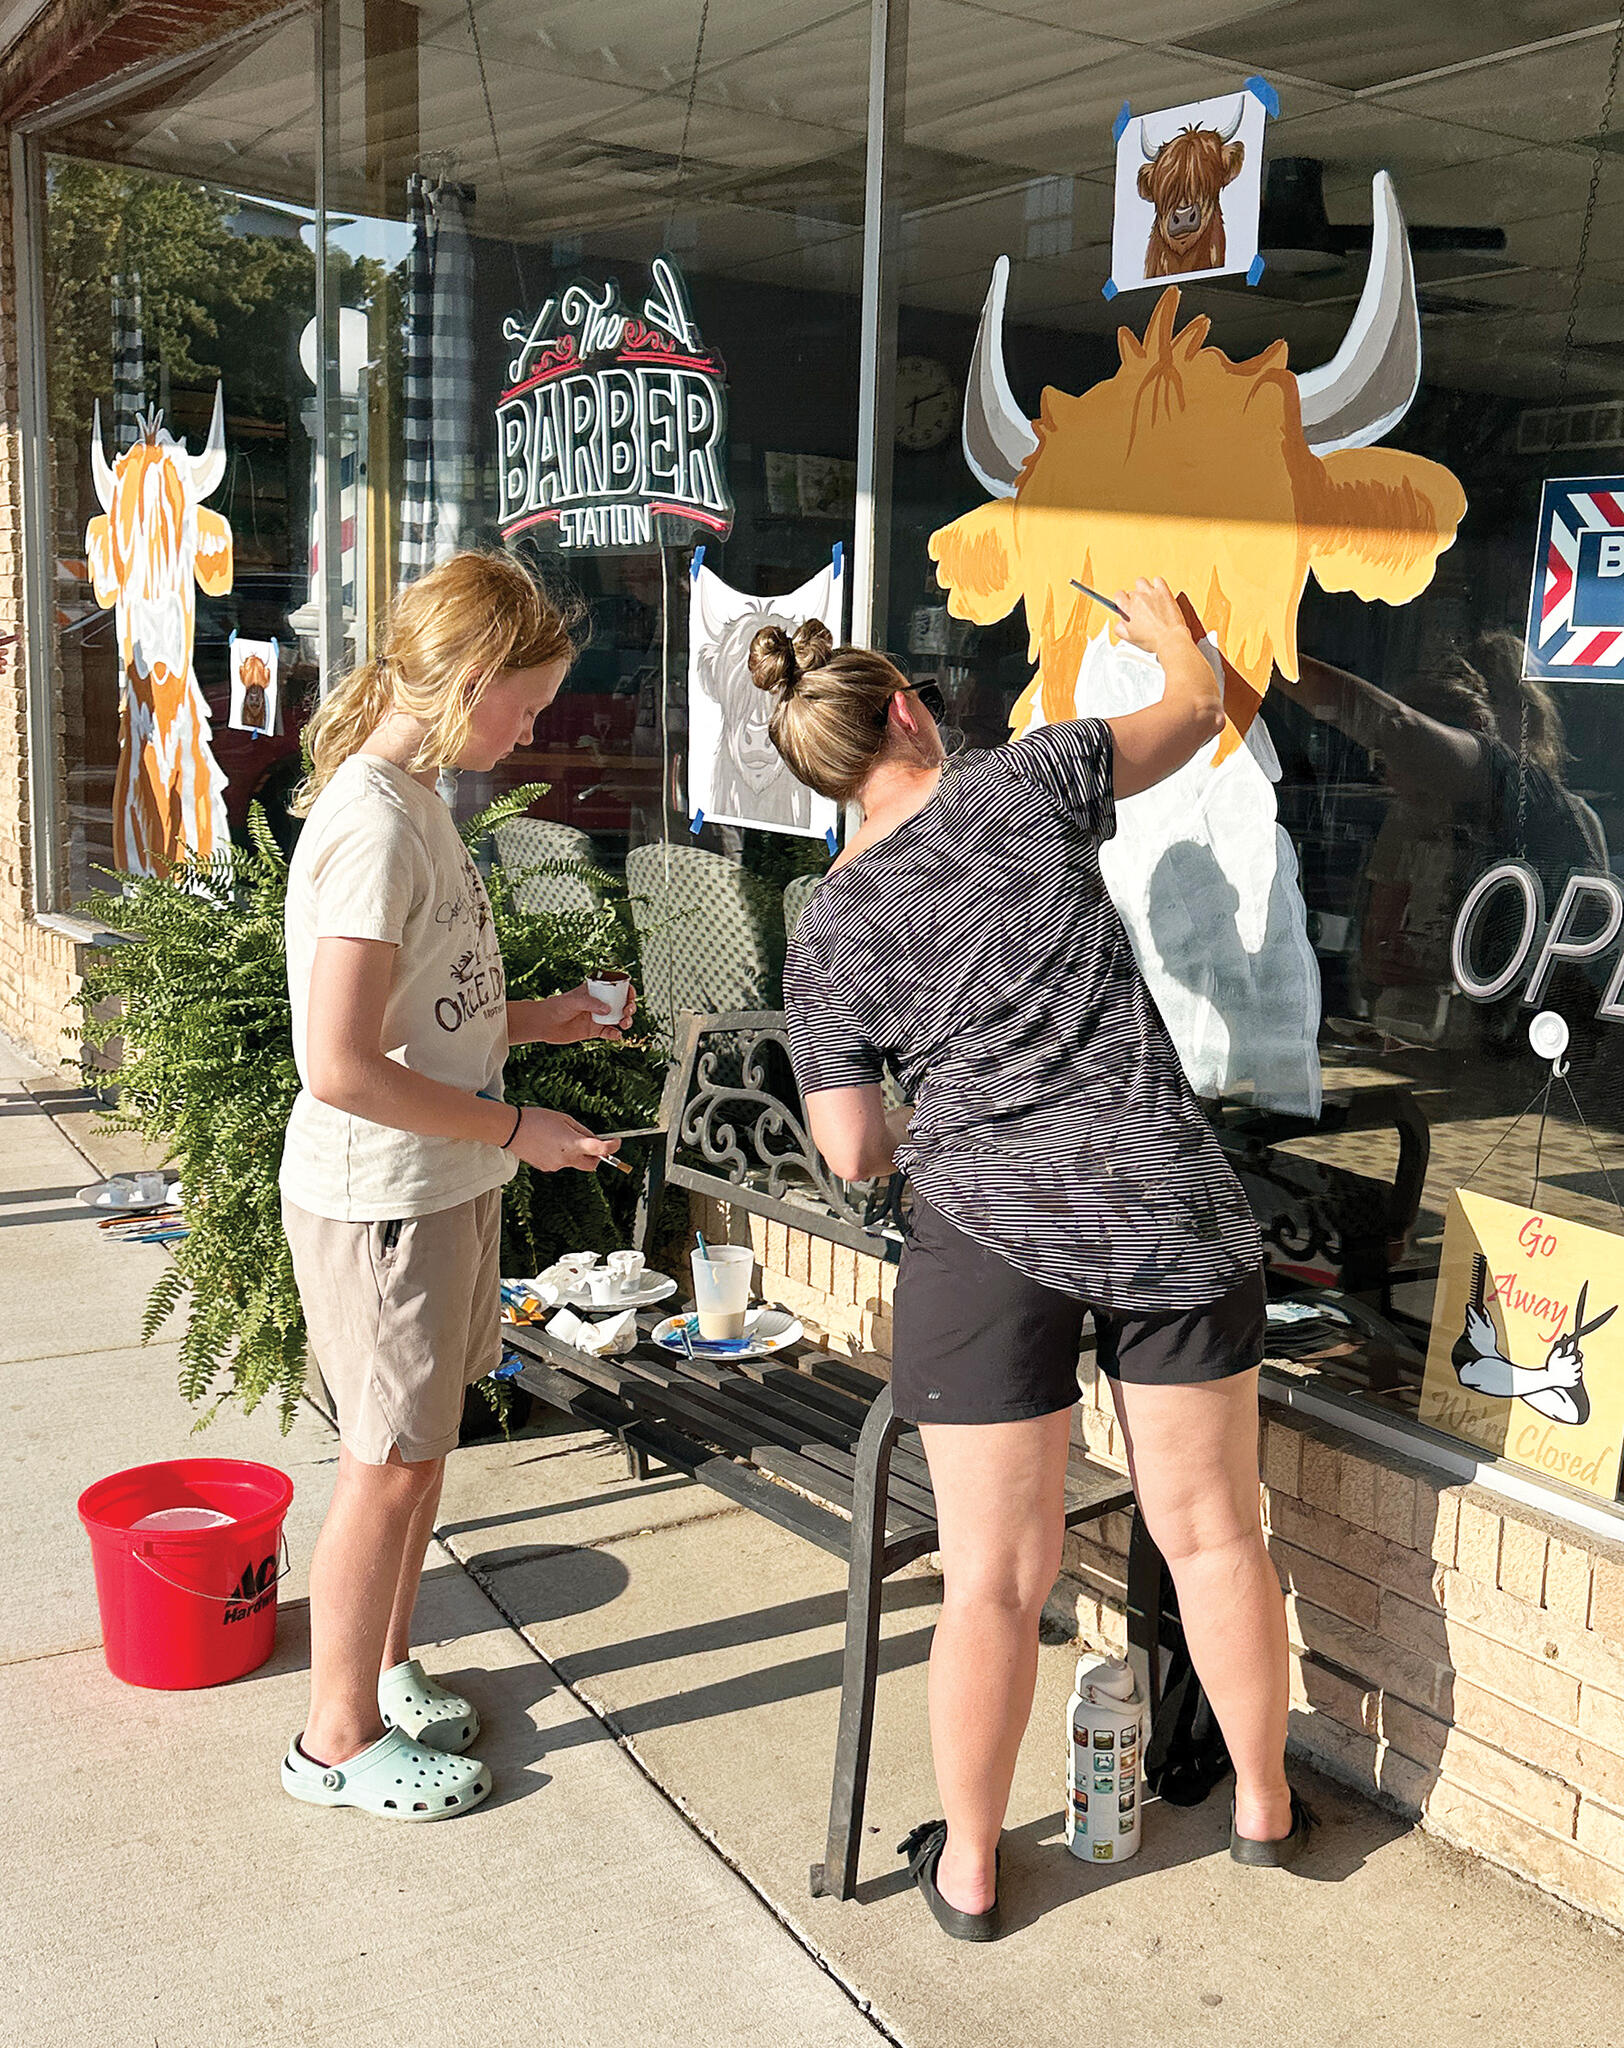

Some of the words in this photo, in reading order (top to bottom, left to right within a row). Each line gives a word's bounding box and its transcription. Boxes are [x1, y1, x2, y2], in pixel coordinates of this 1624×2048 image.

[562, 282, 627, 360] The
[494, 367, 723, 525] BARBER
[559, 505, 650, 547] STATION
[1518, 1216, 1557, 1258] Go
[1487, 1273, 1569, 1343] Away
[1515, 1424, 1614, 1486] Closed
